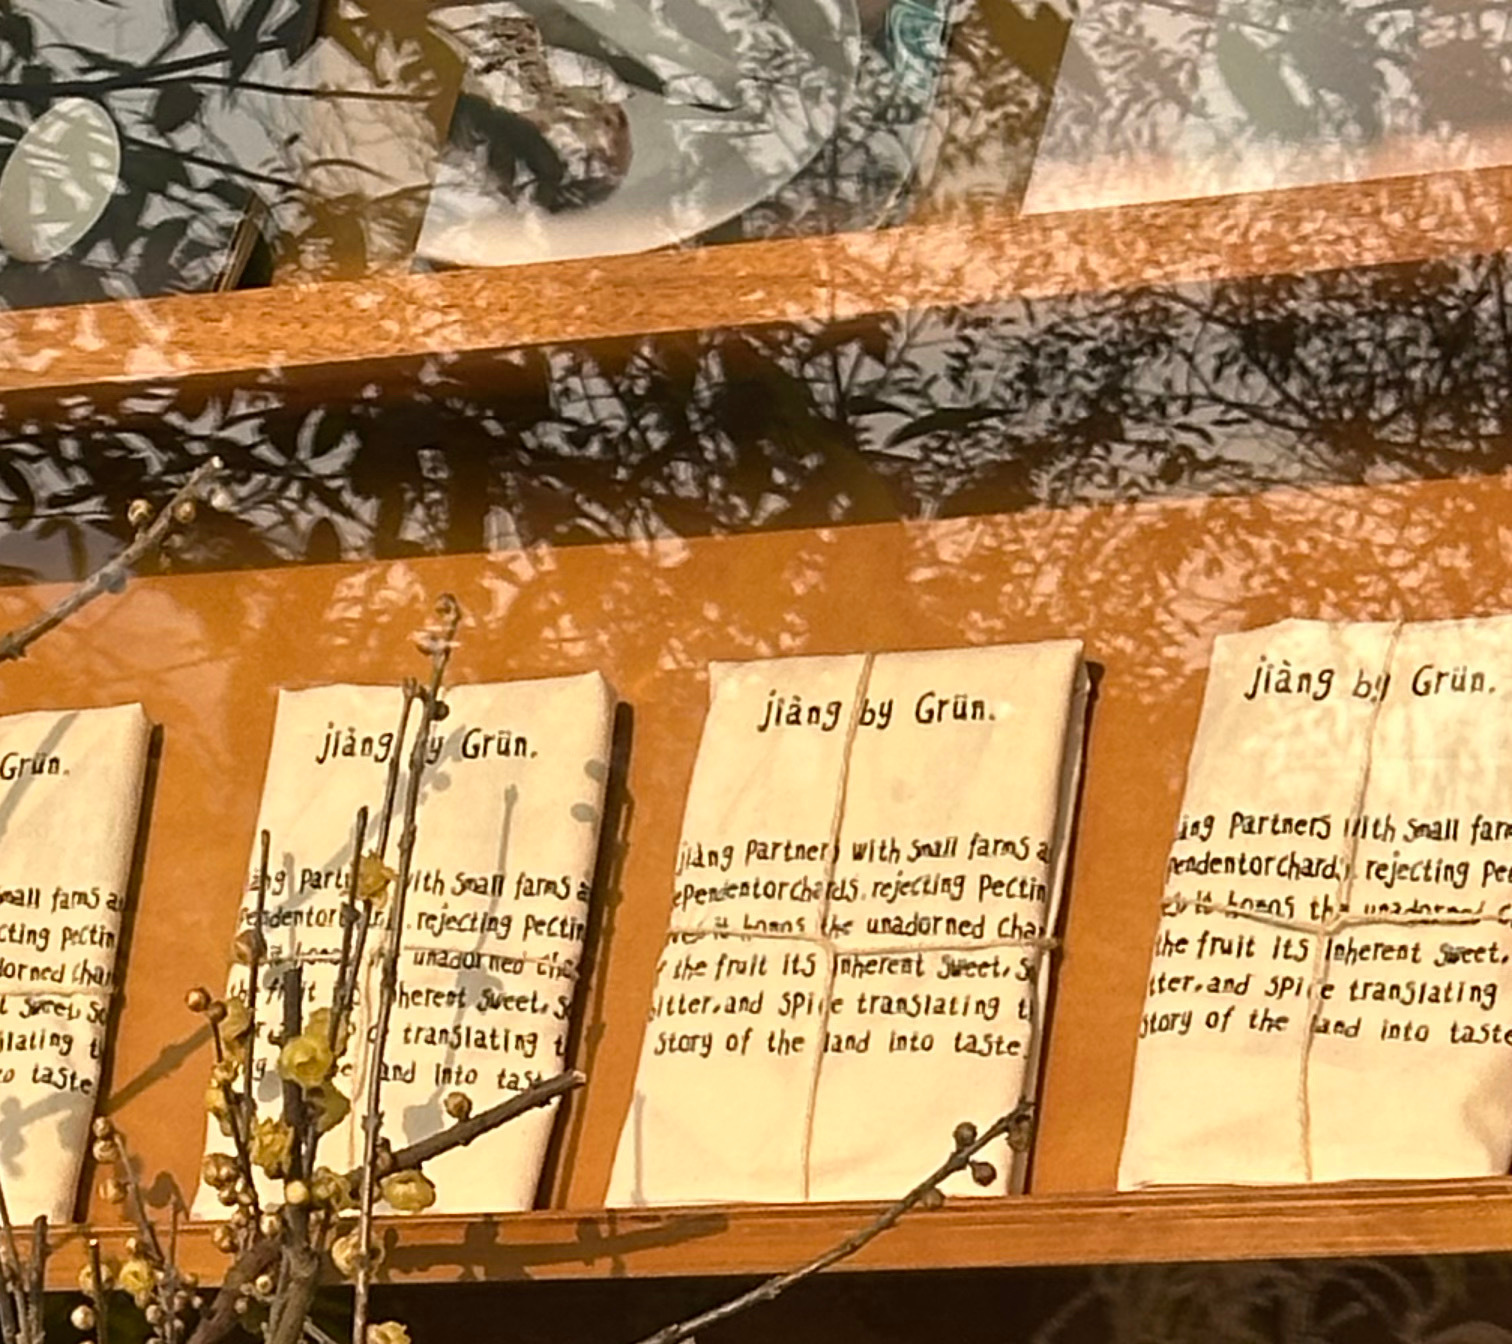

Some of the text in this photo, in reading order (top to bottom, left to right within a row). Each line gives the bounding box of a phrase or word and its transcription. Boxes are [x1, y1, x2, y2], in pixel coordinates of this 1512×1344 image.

[1243, 653, 1496, 703] jiàng by Grün.
[858, 698, 894, 730] by
[915, 690, 996, 725] Grün.
[462, 727, 538, 760] Grün.
[1229, 811, 1332, 840] partners
[852, 837, 900, 864] with
[1366, 850, 1470, 889] rejecting
[872, 870, 966, 904] rejecting
[979, 874, 1047, 904] pectin
[417, 902, 513, 940] rejecting
[867, 912, 986, 940] unadorned
[1197, 929, 1256, 960] fruit
[1272, 935, 1309, 963] its
[1326, 936, 1422, 966] inherent
[714, 952, 768, 981] fruit
[782, 952, 816, 977] its
[857, 992, 1000, 1021] translating
[1349, 978, 1498, 1011] translating
[1205, 1004, 1236, 1033] of
[1248, 1007, 1290, 1033] the
[1380, 1018, 1430, 1042] into
[403, 1025, 538, 1059] translating
[654, 1031, 713, 1059] story
[725, 1027, 753, 1056] of
[767, 1028, 806, 1056] the
[823, 1030, 871, 1055] land
[889, 1029, 934, 1054] into
[32, 1063, 93, 1095] taste
[435, 1062, 478, 1087] into
